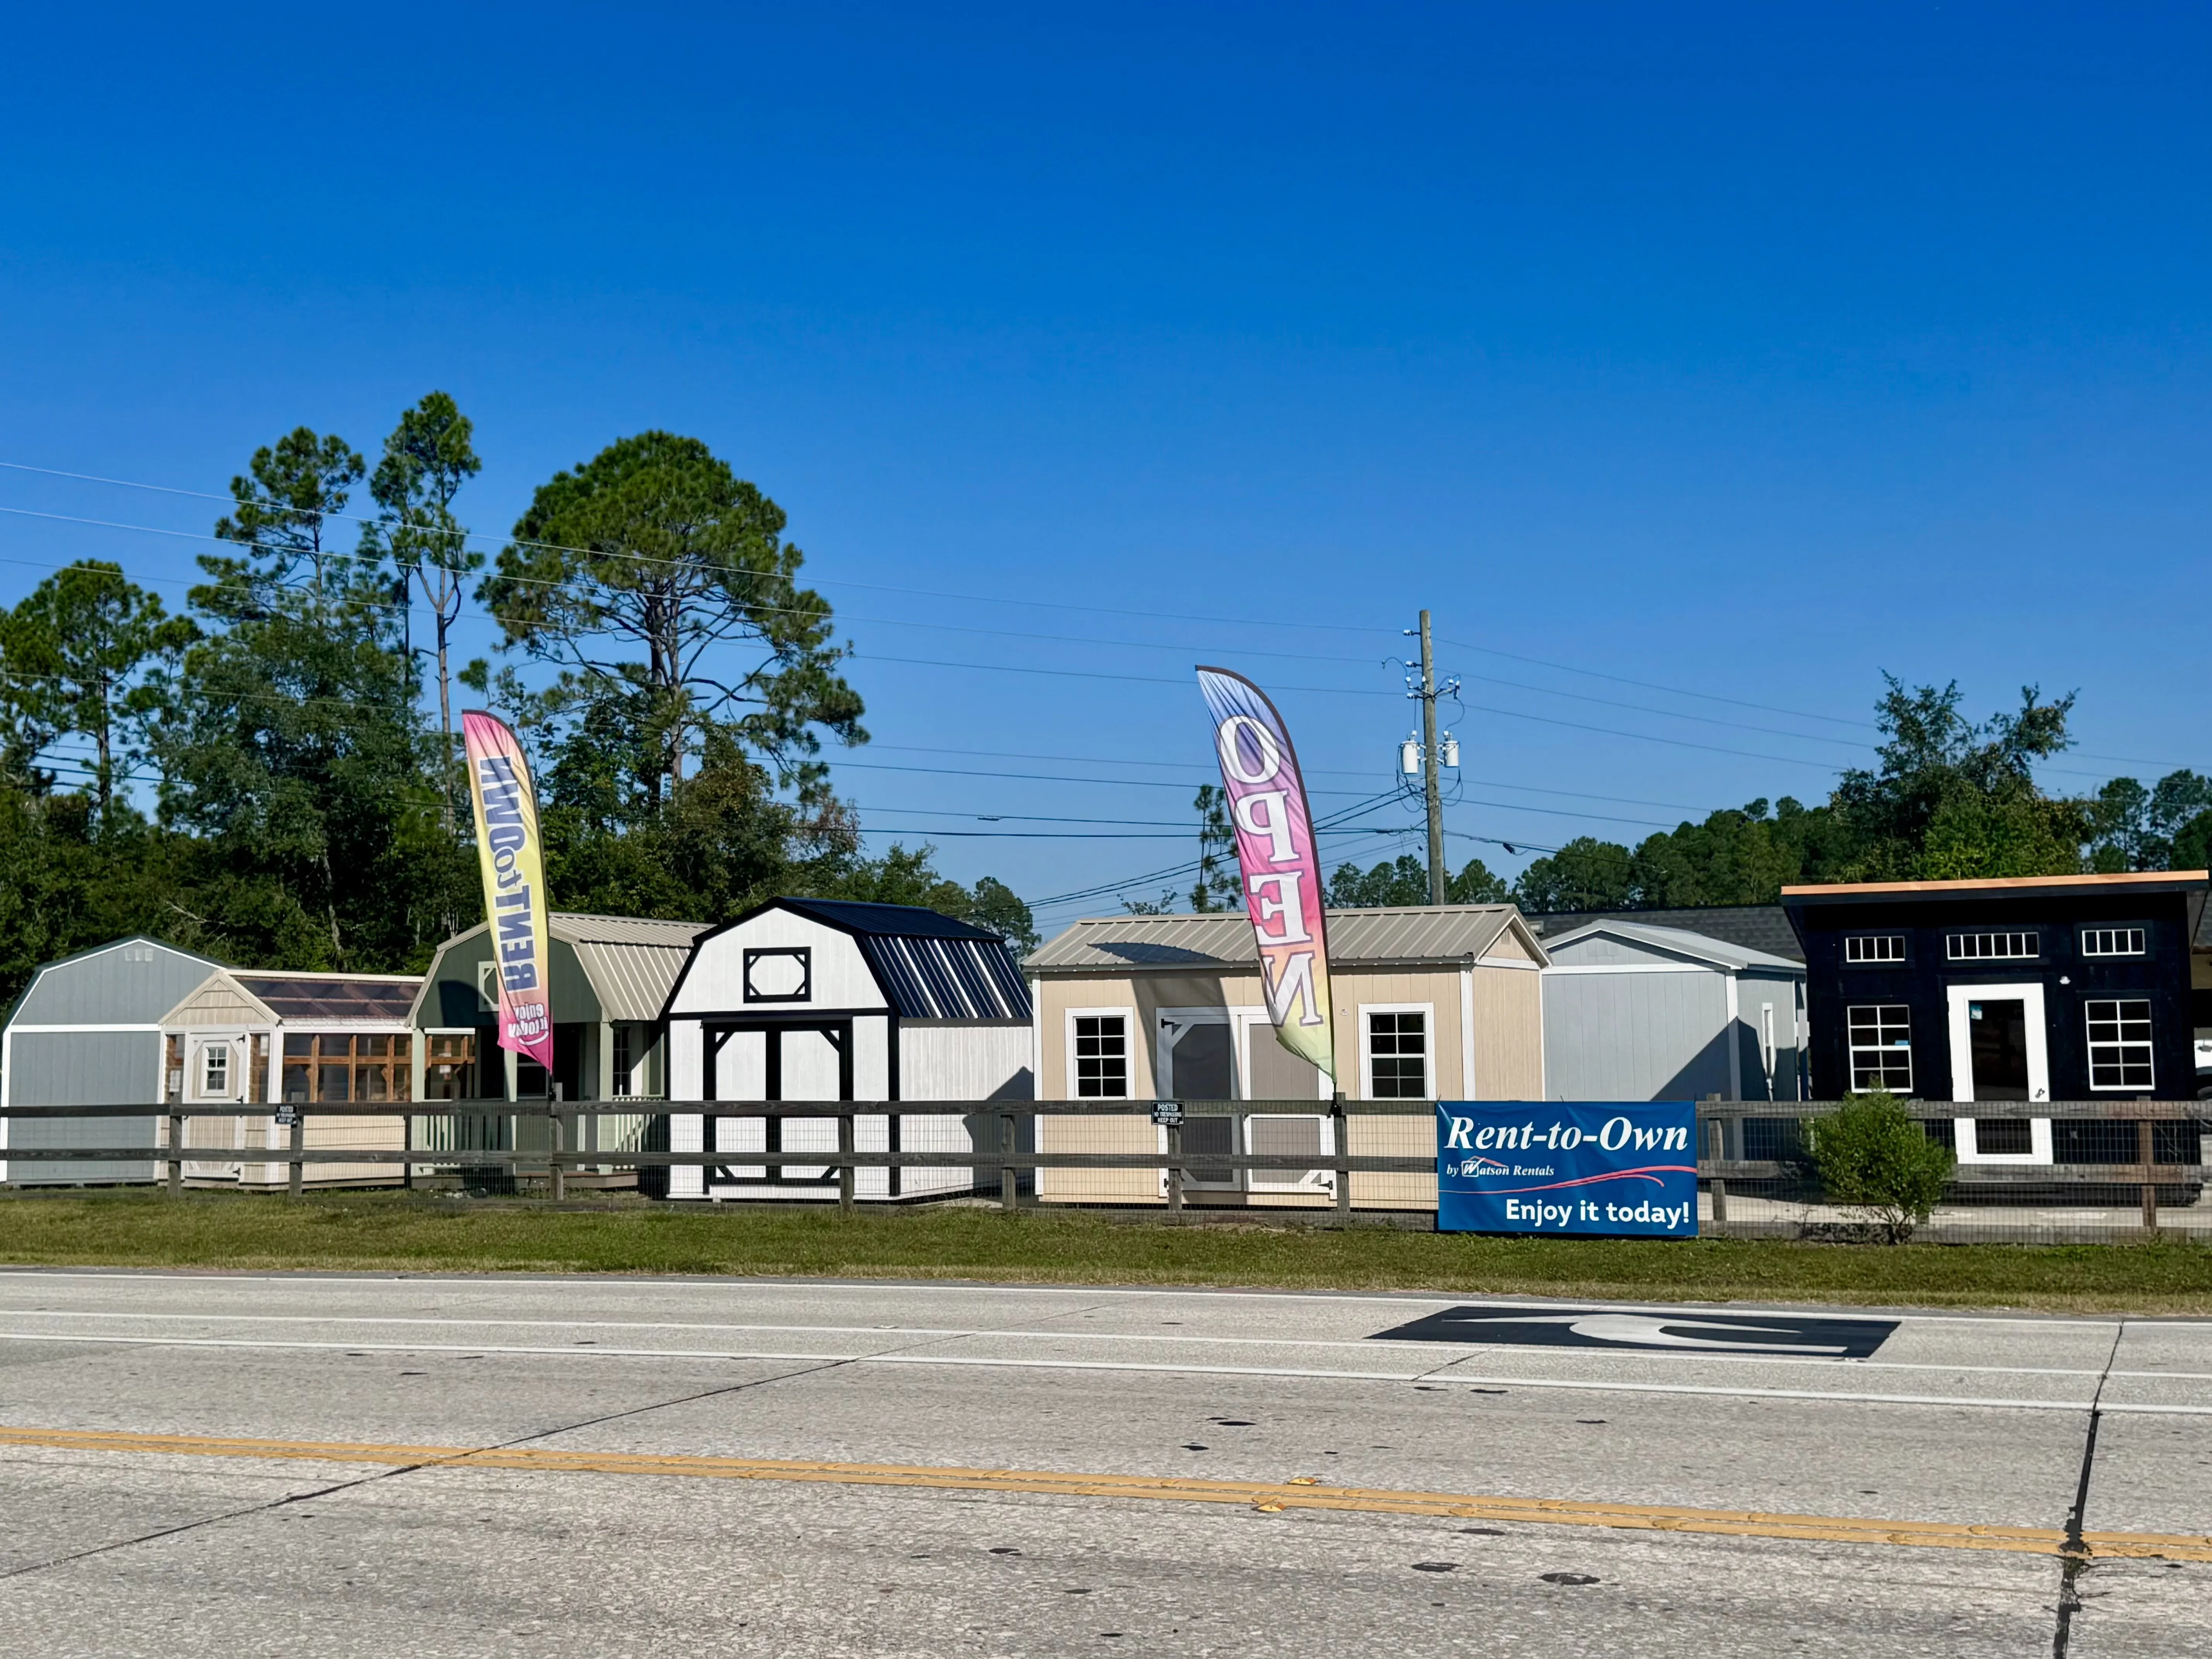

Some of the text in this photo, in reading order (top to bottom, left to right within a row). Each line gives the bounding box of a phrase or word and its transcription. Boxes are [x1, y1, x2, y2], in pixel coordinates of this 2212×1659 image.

[1444, 1116, 1688, 1151] Rent-to-Own
[1446, 1158, 1554, 1177] by Watson Rentals
[1506, 1199, 1690, 1230] Enjoy it today!
